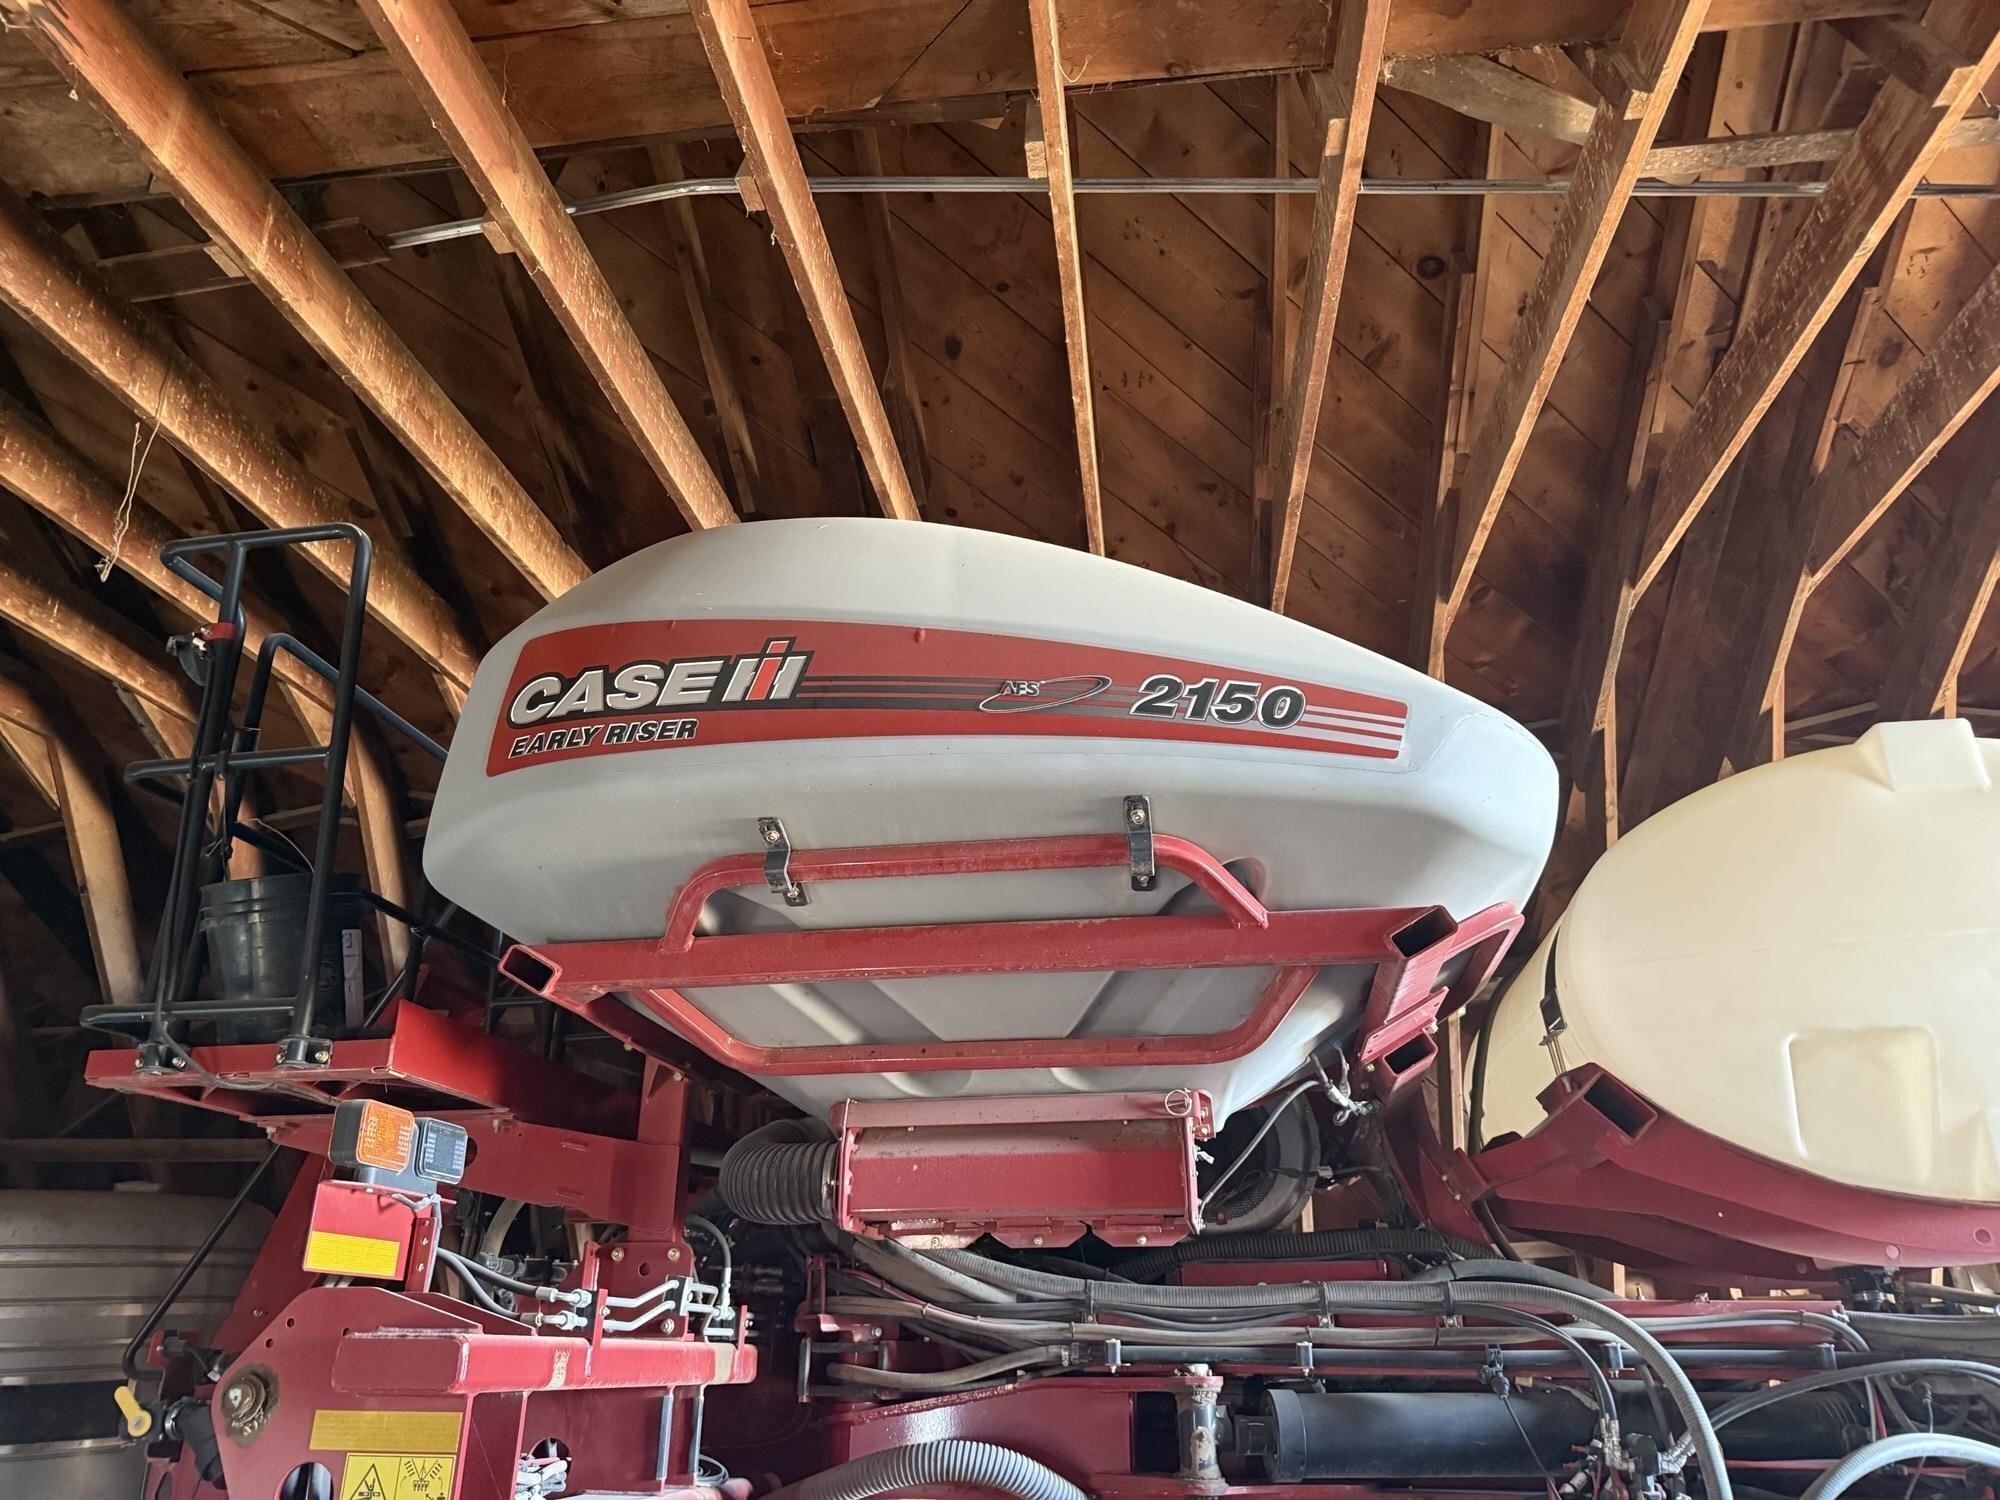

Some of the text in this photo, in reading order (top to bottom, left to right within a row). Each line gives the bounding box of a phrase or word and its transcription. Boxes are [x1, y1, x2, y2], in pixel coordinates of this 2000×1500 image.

[509, 659, 725, 726] CASE
[999, 680, 1041, 697] AFS
[1129, 674, 1307, 729] 2150
[508, 719, 699, 758] EARLY RISER
